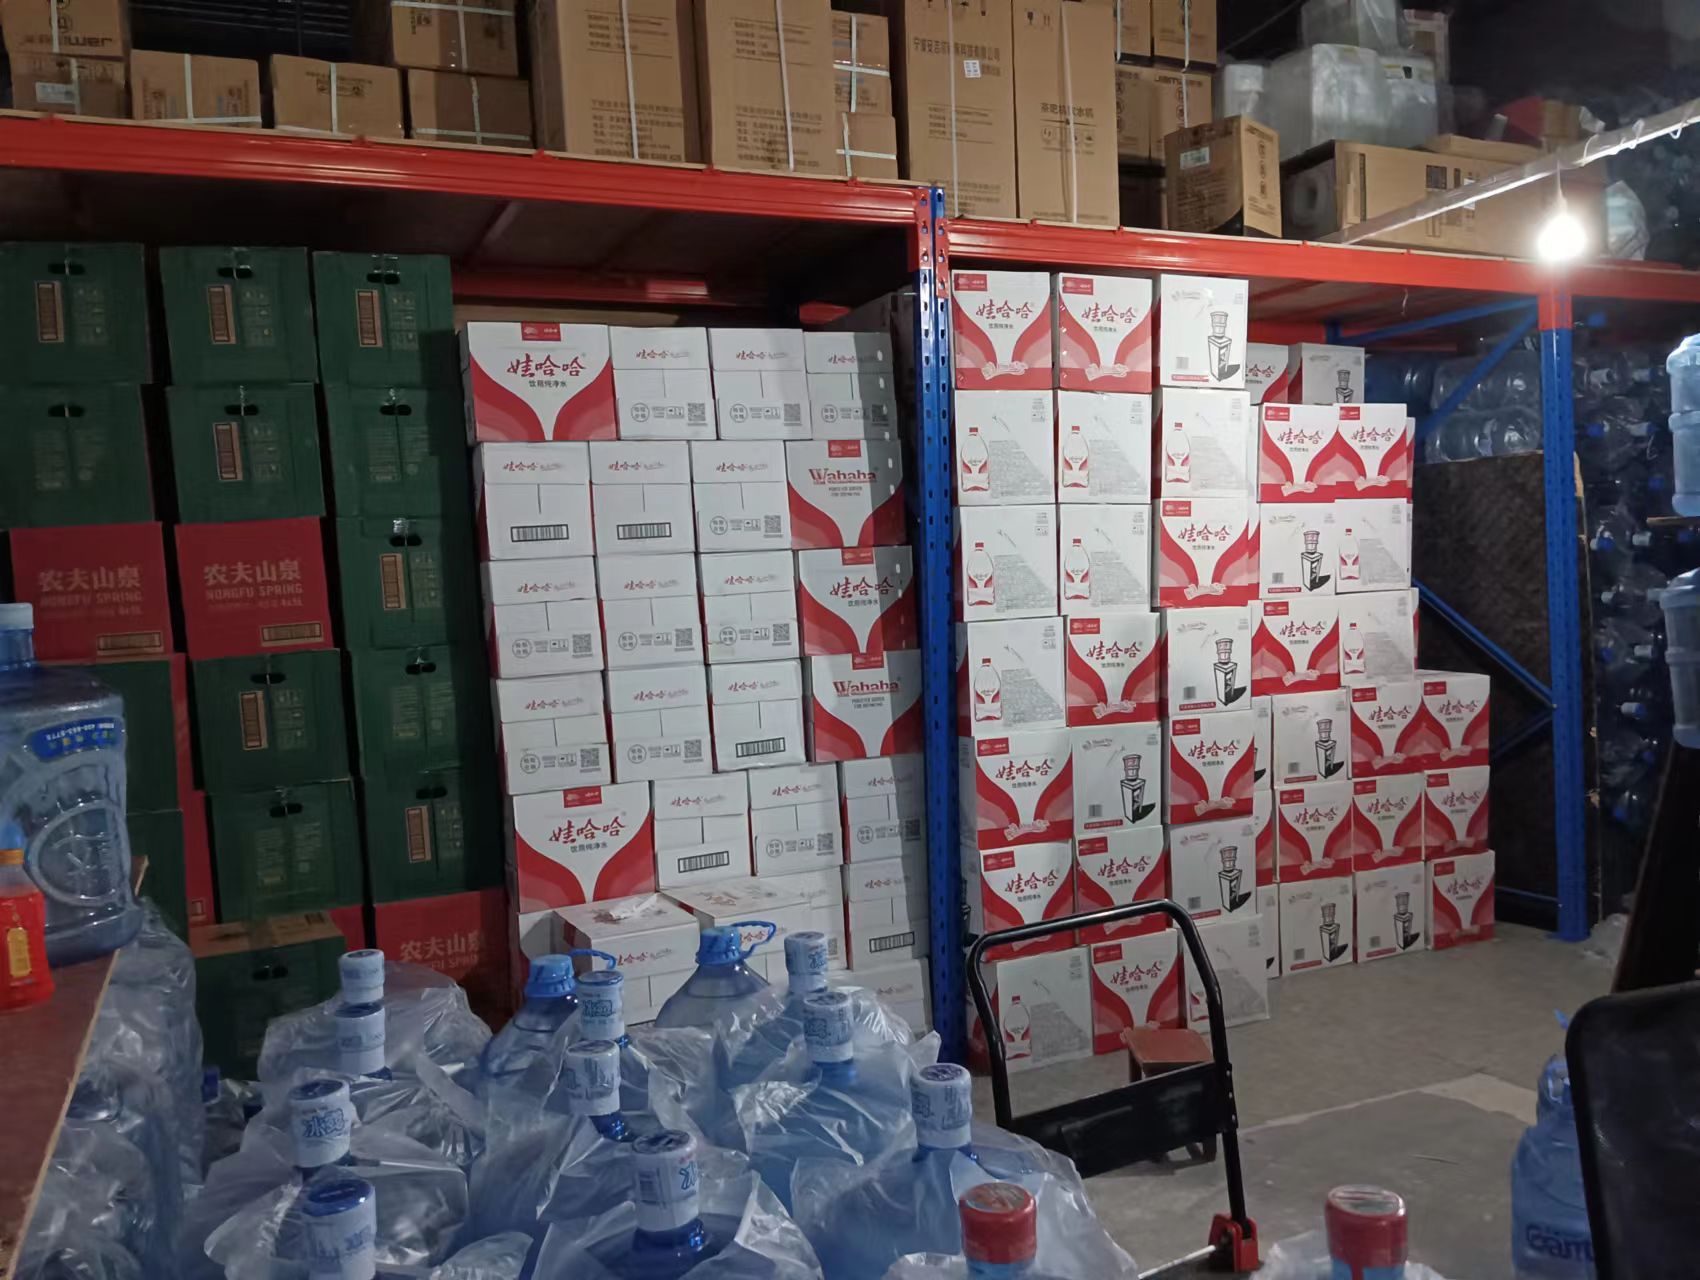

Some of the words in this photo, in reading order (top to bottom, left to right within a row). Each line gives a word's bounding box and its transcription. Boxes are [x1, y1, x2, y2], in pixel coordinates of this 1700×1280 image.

[976, 299, 1033, 319] 娃哈哈
[1082, 302, 1137, 323] 娃哈哈
[507, 353, 586, 377] 娃哈哈
[1277, 430, 1322, 444] 娃哈哈
[1351, 427, 1393, 442] 娃哈哈
[809, 468, 876, 485] Wahaha
[1178, 523, 1230, 541] 娃哈哈
[39, 565, 141, 592] 农夫山泉
[203, 558, 302, 586] 农夫山泉
[830, 576, 894, 598] 娃哈哈
[1280, 620, 1324, 637] 娃哈哈
[1087, 641, 1140, 659] 娃哈哈
[833, 681, 899, 697] Wahaha
[1369, 705, 1410, 722] 娃哈哈
[1188, 740, 1239, 759] 娃哈哈
[996, 759, 1053, 780] 娃哈哈
[1294, 807, 1336, 824] 娃哈哈
[549, 815, 626, 844] 娃哈哈
[1098, 857, 1148, 878] 娃哈哈
[1005, 871, 1058, 892] 娃哈哈
[1111, 961, 1161, 985] 娃哈哈
